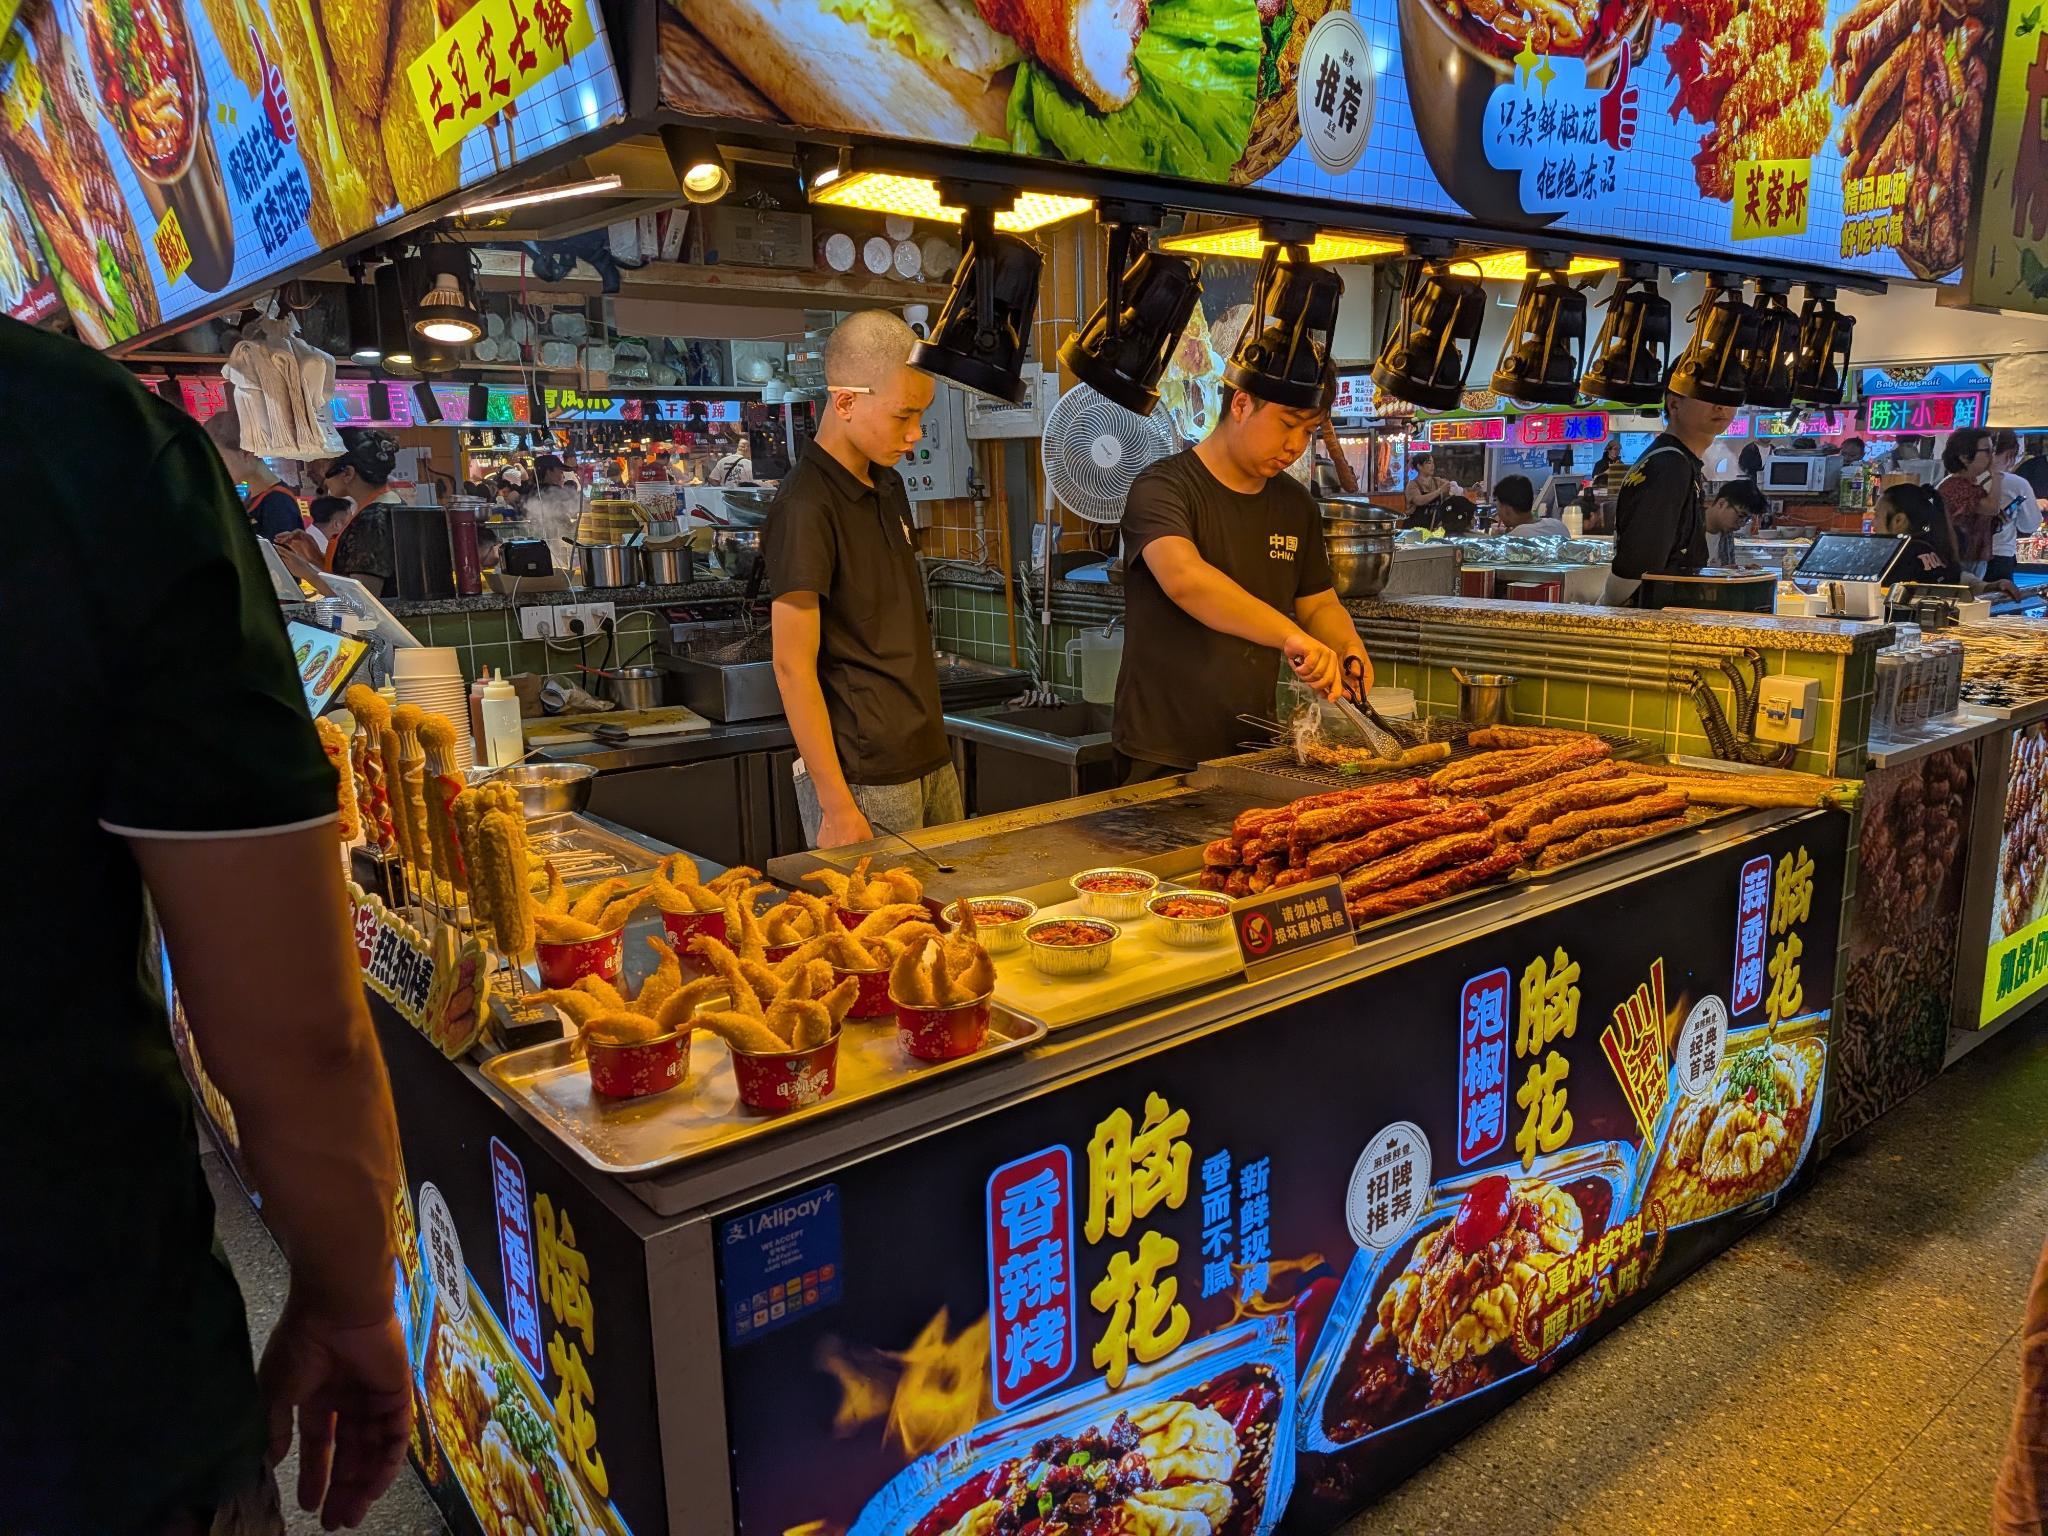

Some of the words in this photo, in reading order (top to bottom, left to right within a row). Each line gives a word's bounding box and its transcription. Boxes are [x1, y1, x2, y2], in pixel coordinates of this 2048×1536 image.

[1314, 53, 1363, 135] 推荐
[1497, 98, 1600, 149] 只卖鲜脑花
[1536, 152, 1617, 201] 拒绝冻品
[1743, 164, 1808, 230] 芙蓉虾
[1843, 169, 1907, 215] 精品肥肠
[1840, 211, 1905, 259] 好吃不腻
[1871, 398, 1976, 430] 捞汁小海鲜
[1917, 377, 1941, 387] snail
[1269, 533, 1298, 552] 中国
[1274, 911, 1345, 945] 损坏照价赔偿
[1281, 896, 1329, 923] 请勿触摸
[1737, 868, 1768, 1004] 蒜香烤
[1765, 845, 1815, 1030] 脑花
[1465, 986, 1504, 1151] 泡椒烤
[1515, 945, 1582, 1169] 脑花
[1366, 1189, 1413, 1237] 推荐
[1367, 1160, 1413, 1206] 招牌
[1084, 1091, 1193, 1389] 脑花
[1201, 1148, 1234, 1300] 香而不腻
[1239, 1156, 1272, 1304] 新鲜现烤
[1545, 1213, 1644, 1305] 真材实料
[1000, 1167, 1067, 1390] 香辣烤
[1542, 1256, 1641, 1352] 醇正入味
[533, 1191, 610, 1499] 脑花
